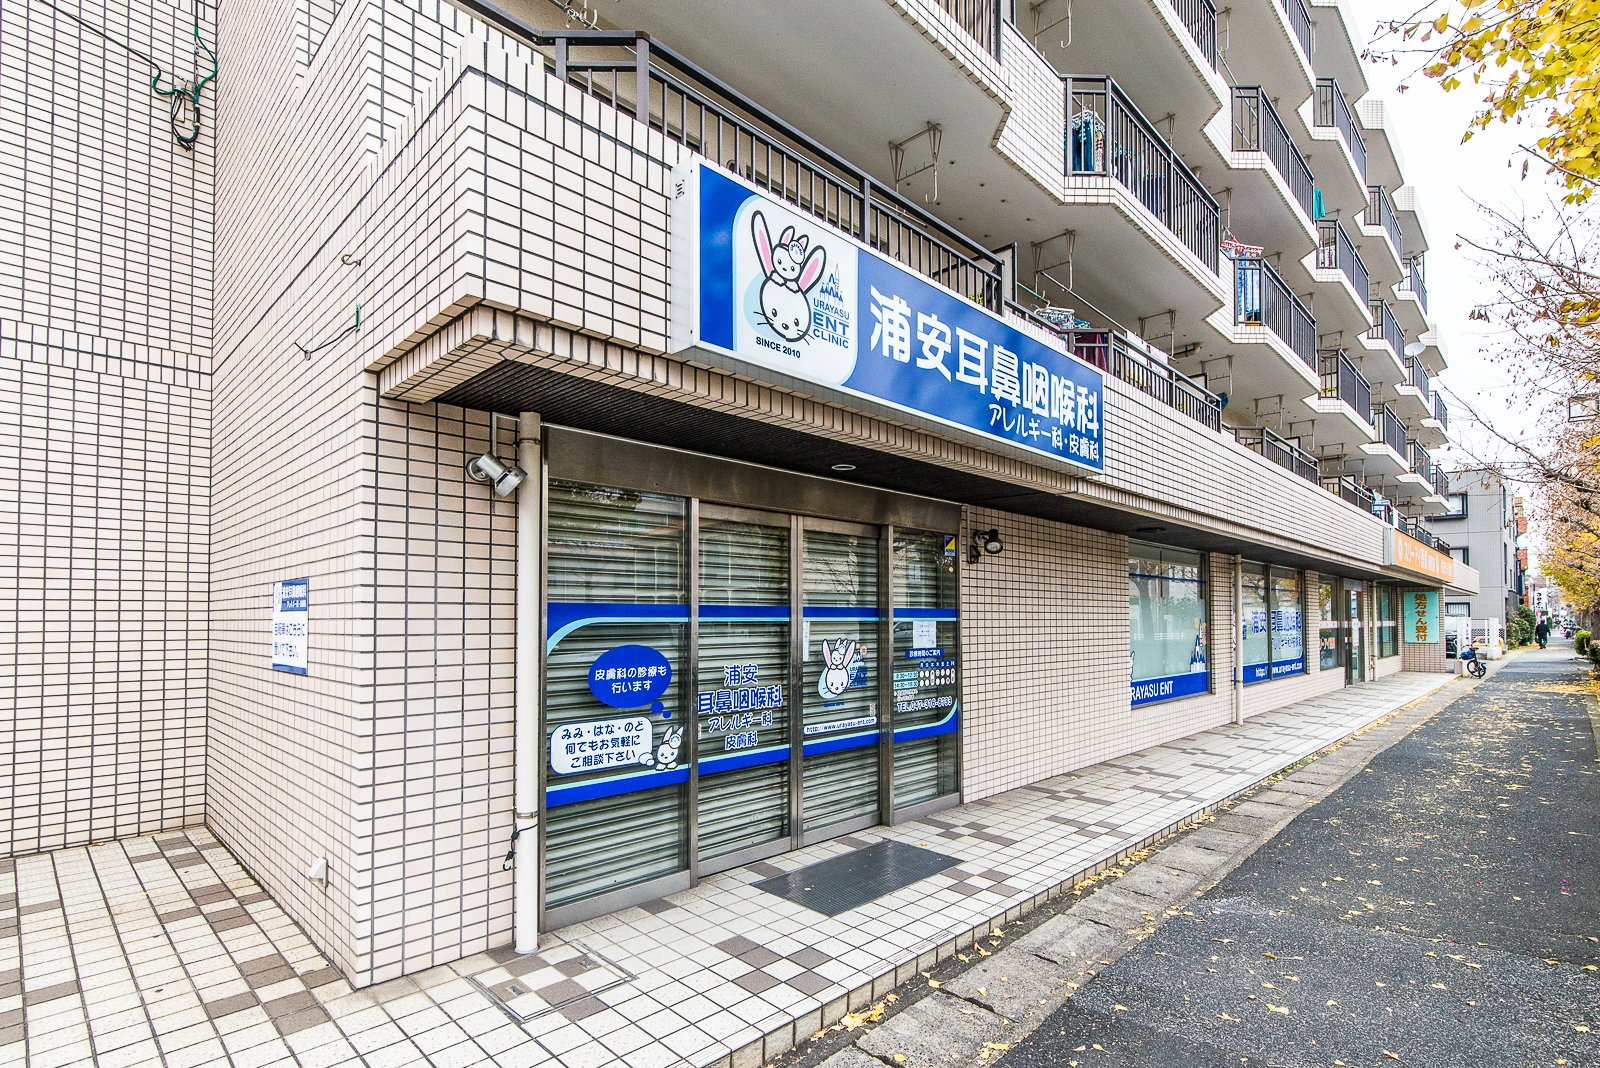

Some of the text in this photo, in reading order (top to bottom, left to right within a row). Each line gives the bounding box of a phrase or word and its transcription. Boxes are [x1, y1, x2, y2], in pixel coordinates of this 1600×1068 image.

[814, 298, 850, 320] URAYASU
[813, 312, 850, 335] ENT
[756, 336, 800, 358] SINCE 2010
[814, 328, 849, 348] CLINIC
[870, 285, 1099, 438] 浦安耳鼻咽喉科
[989, 404, 1099, 462] アレルギー科・皮膚科
[1414, 594, 1428, 642] 処方せん受付
[595, 666, 667, 680] 皮膚科の診療も
[724, 664, 758, 686] 浦安
[612, 680, 652, 694] 行います
[1160, 681, 1173, 695] ENT
[698, 685, 783, 714] 耳鼻咽喉科
[561, 721, 644, 739] みみ・はな・のど
[708, 711, 773, 733] アレルギー科
[566, 735, 640, 755] 何でもお気軽に
[725, 731, 758, 750] 皮膚科
[571, 750, 636, 768] ご相談下さい
